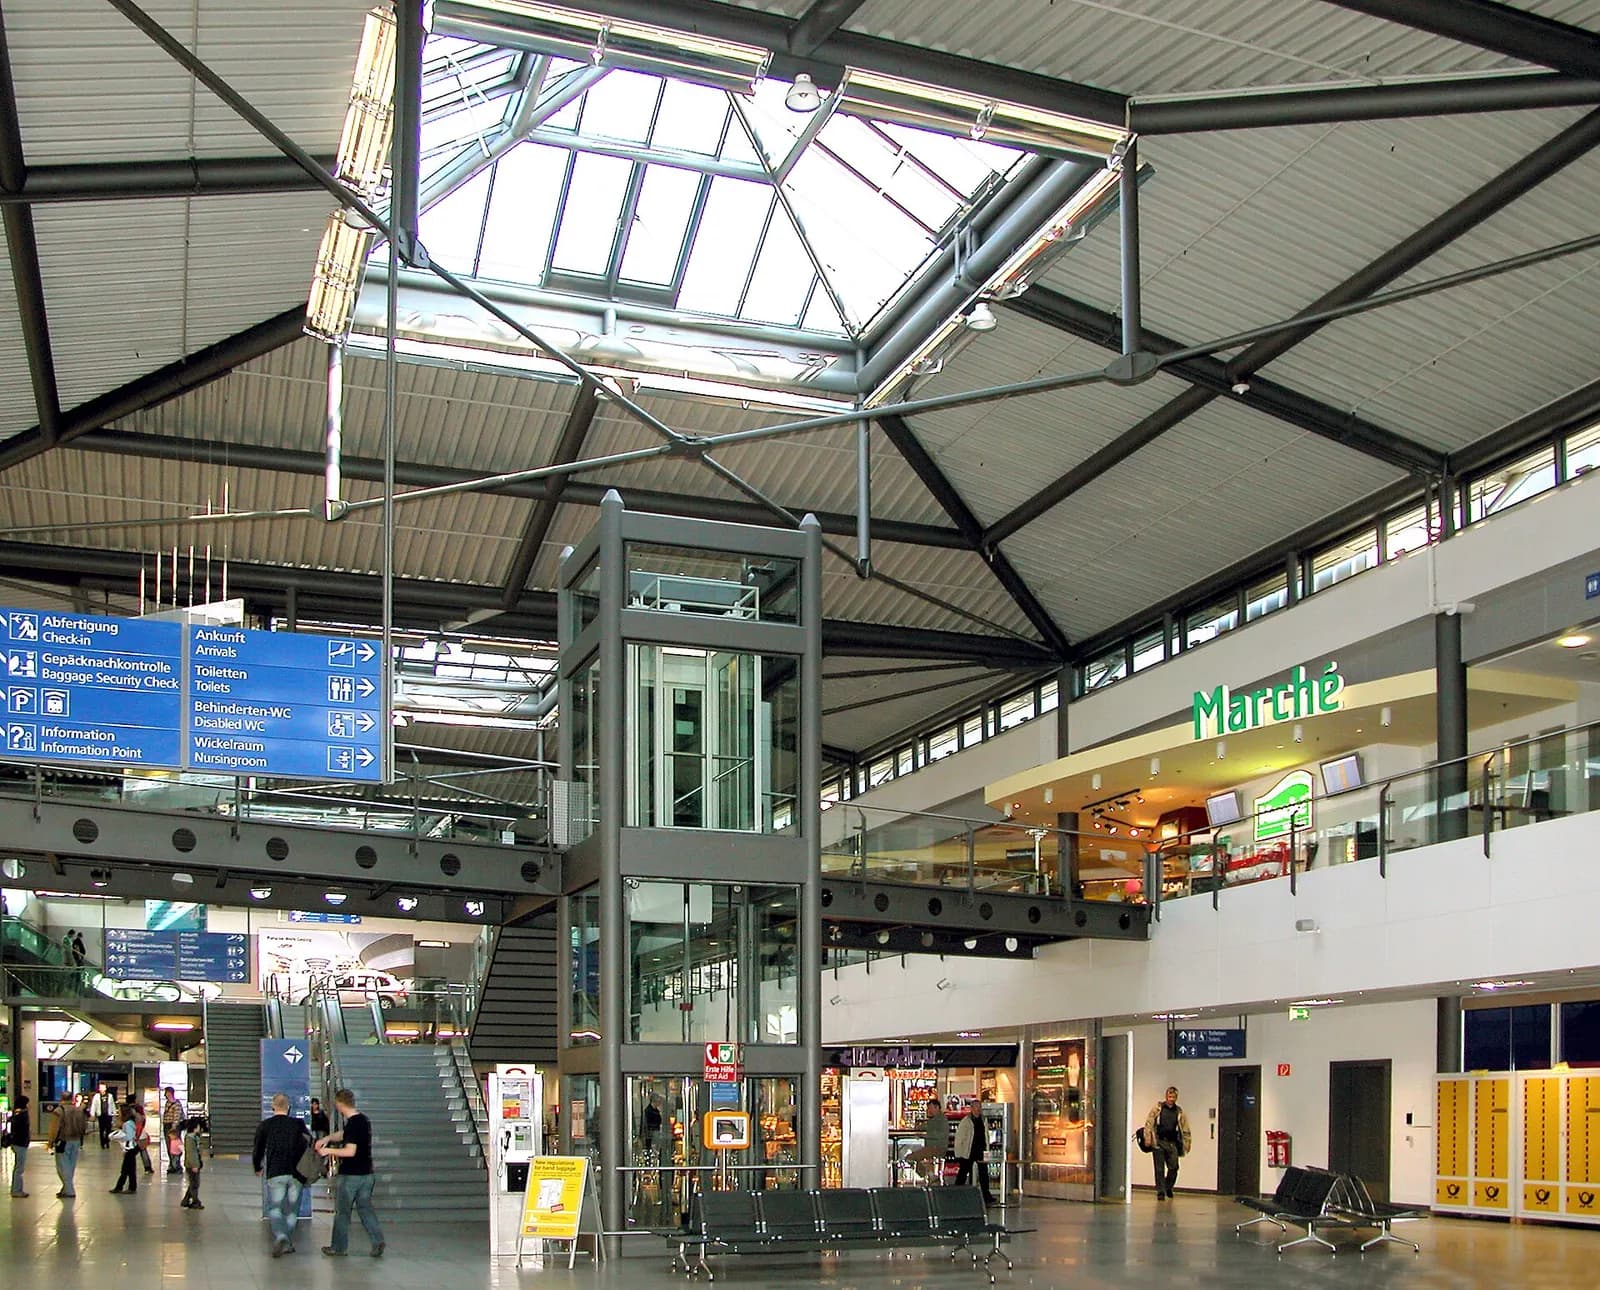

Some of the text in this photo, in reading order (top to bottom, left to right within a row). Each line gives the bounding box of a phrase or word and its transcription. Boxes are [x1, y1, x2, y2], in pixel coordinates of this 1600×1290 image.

[42, 616, 119, 635] Abfertigung
[43, 631, 92, 646] Check-in
[195, 629, 246, 643] Ankunft
[195, 644, 237, 657] Arrivals
[42, 652, 172, 673] Gepäcknachkontrolle
[42, 668, 180, 689] Baggage Security Check
[194, 665, 248, 680] Toiletten
[194, 680, 231, 693] Toilets
[1192, 661, 1344, 740] Marché
[194, 701, 292, 718] Behinderten-WC
[194, 716, 265, 732] Disabled WC
[41, 725, 116, 741] Information
[41, 741, 142, 759] Information Point
[194, 736, 264, 752] Wickelraum
[194, 752, 267, 767] Nursingroom
[705, 1065, 734, 1073] Erste Hilfe
